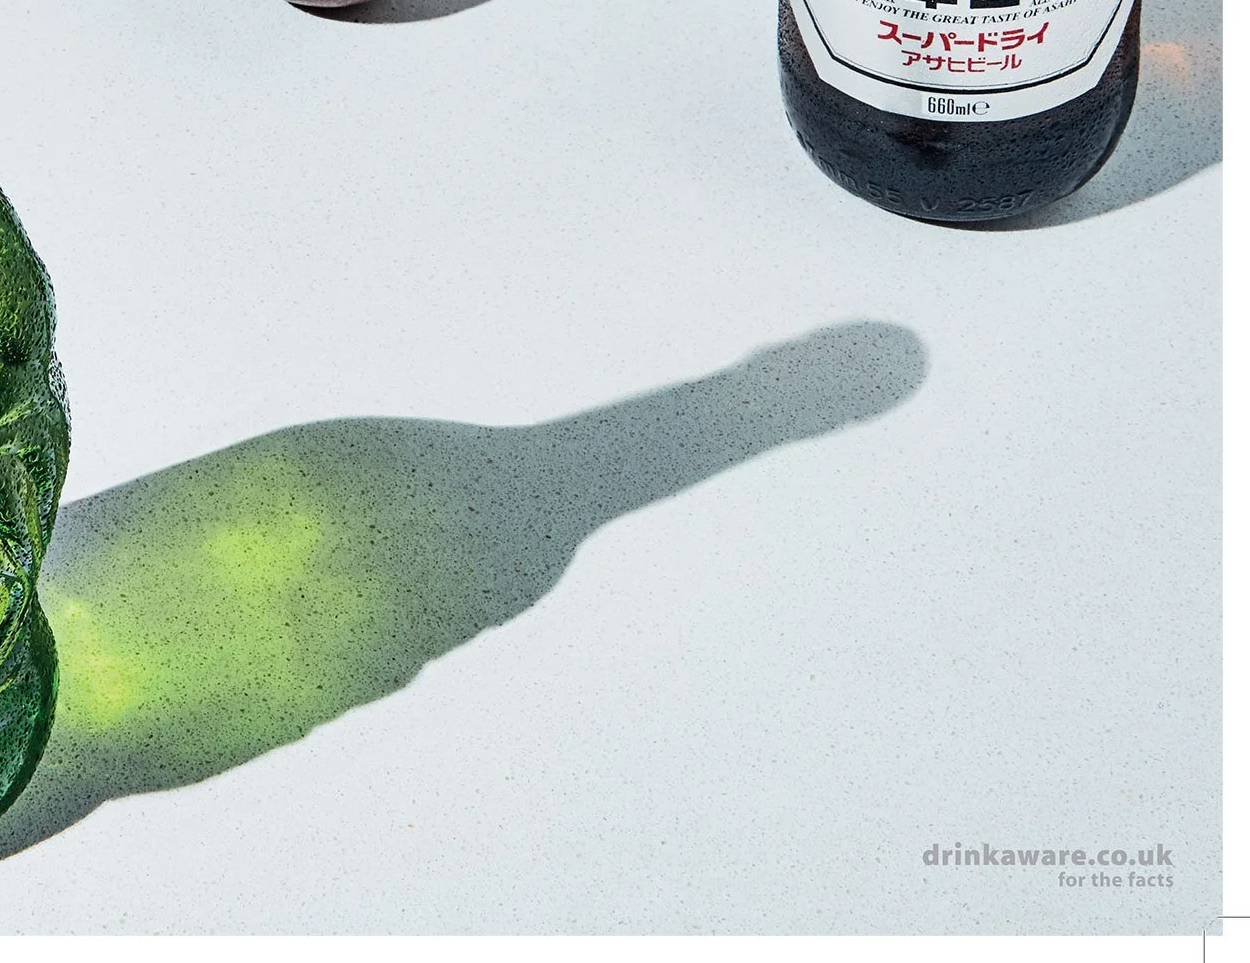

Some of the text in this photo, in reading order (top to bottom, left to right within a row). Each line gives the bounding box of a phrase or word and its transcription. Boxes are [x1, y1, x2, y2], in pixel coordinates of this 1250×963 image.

[902, 8, 929, 21] THE
[932, 14, 978, 25] GREAT
[981, 11, 1022, 24] TASTE
[1023, 7, 1041, 19] OF
[878, 20, 1049, 52] スーパードライ
[901, 50, 1022, 73] アサヒビール
[957, 189, 1034, 213] 2587
